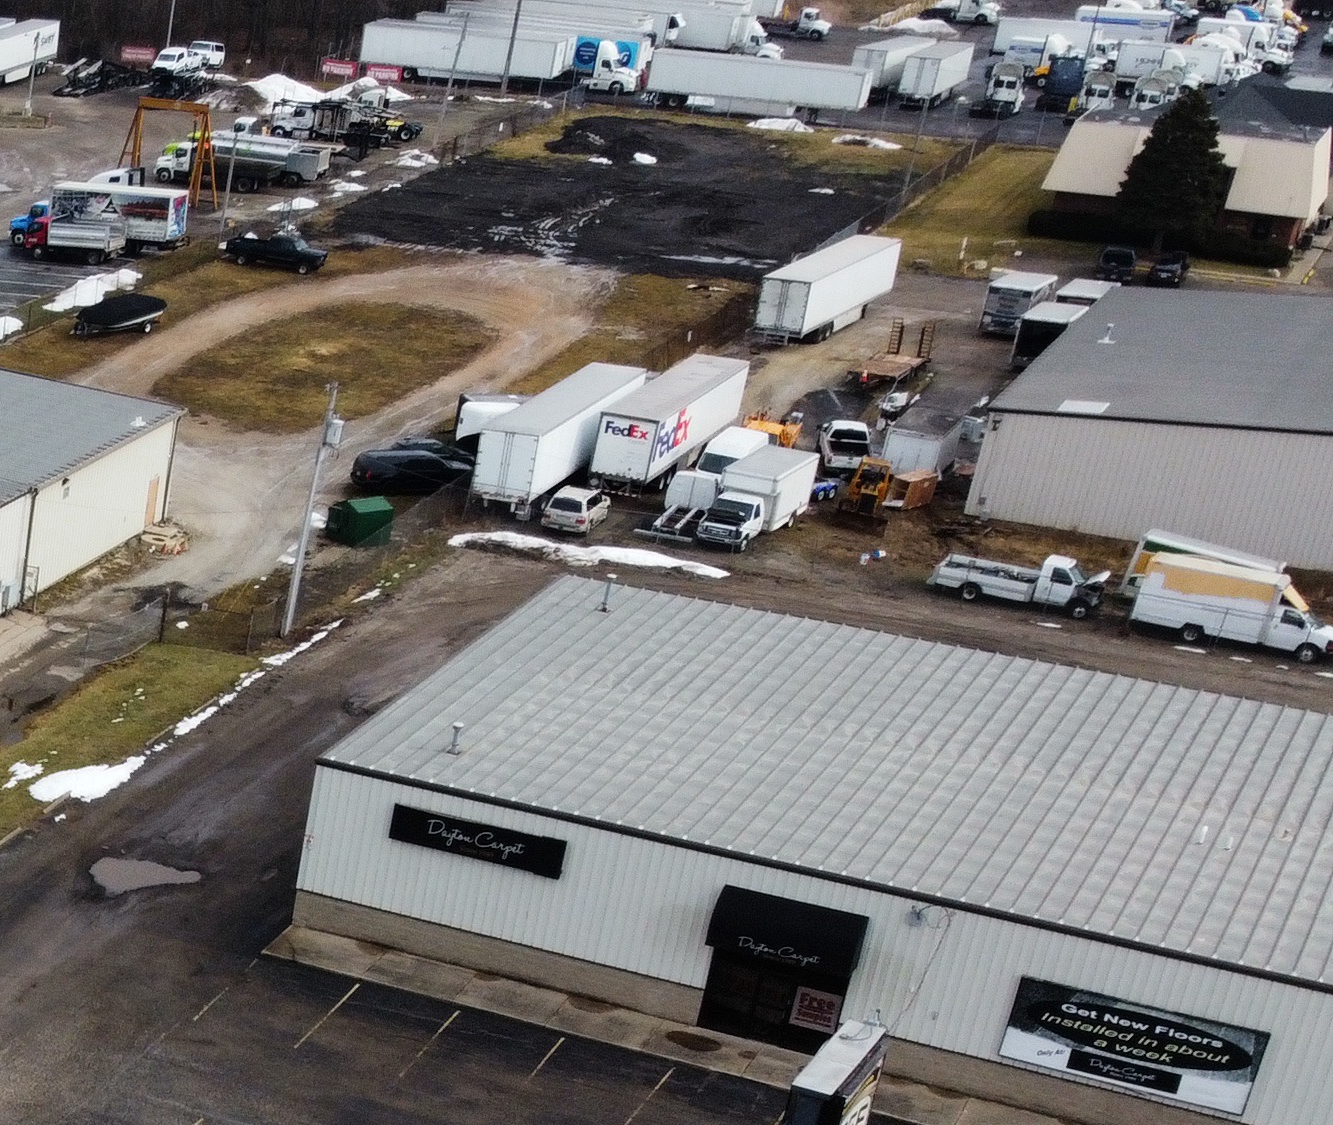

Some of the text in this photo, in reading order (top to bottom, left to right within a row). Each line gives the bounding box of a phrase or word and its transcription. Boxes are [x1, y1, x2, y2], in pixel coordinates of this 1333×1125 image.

[604, 420, 649, 440] FedEx
[652, 407, 692, 463] FedEx
[427, 819, 474, 847] Dayton
[474, 831, 526, 859] Carpet
[738, 936, 776, 955] Dayton
[777, 946, 821, 967] Carpet
[798, 991, 836, 1011] Free
[1040, 1012, 1231, 1065] Installed in about
[1061, 1003, 1224, 1049] Get New Floors
[1093, 1038, 1174, 1064] a week
[1088, 1057, 1156, 1083] Dayton Carpet
